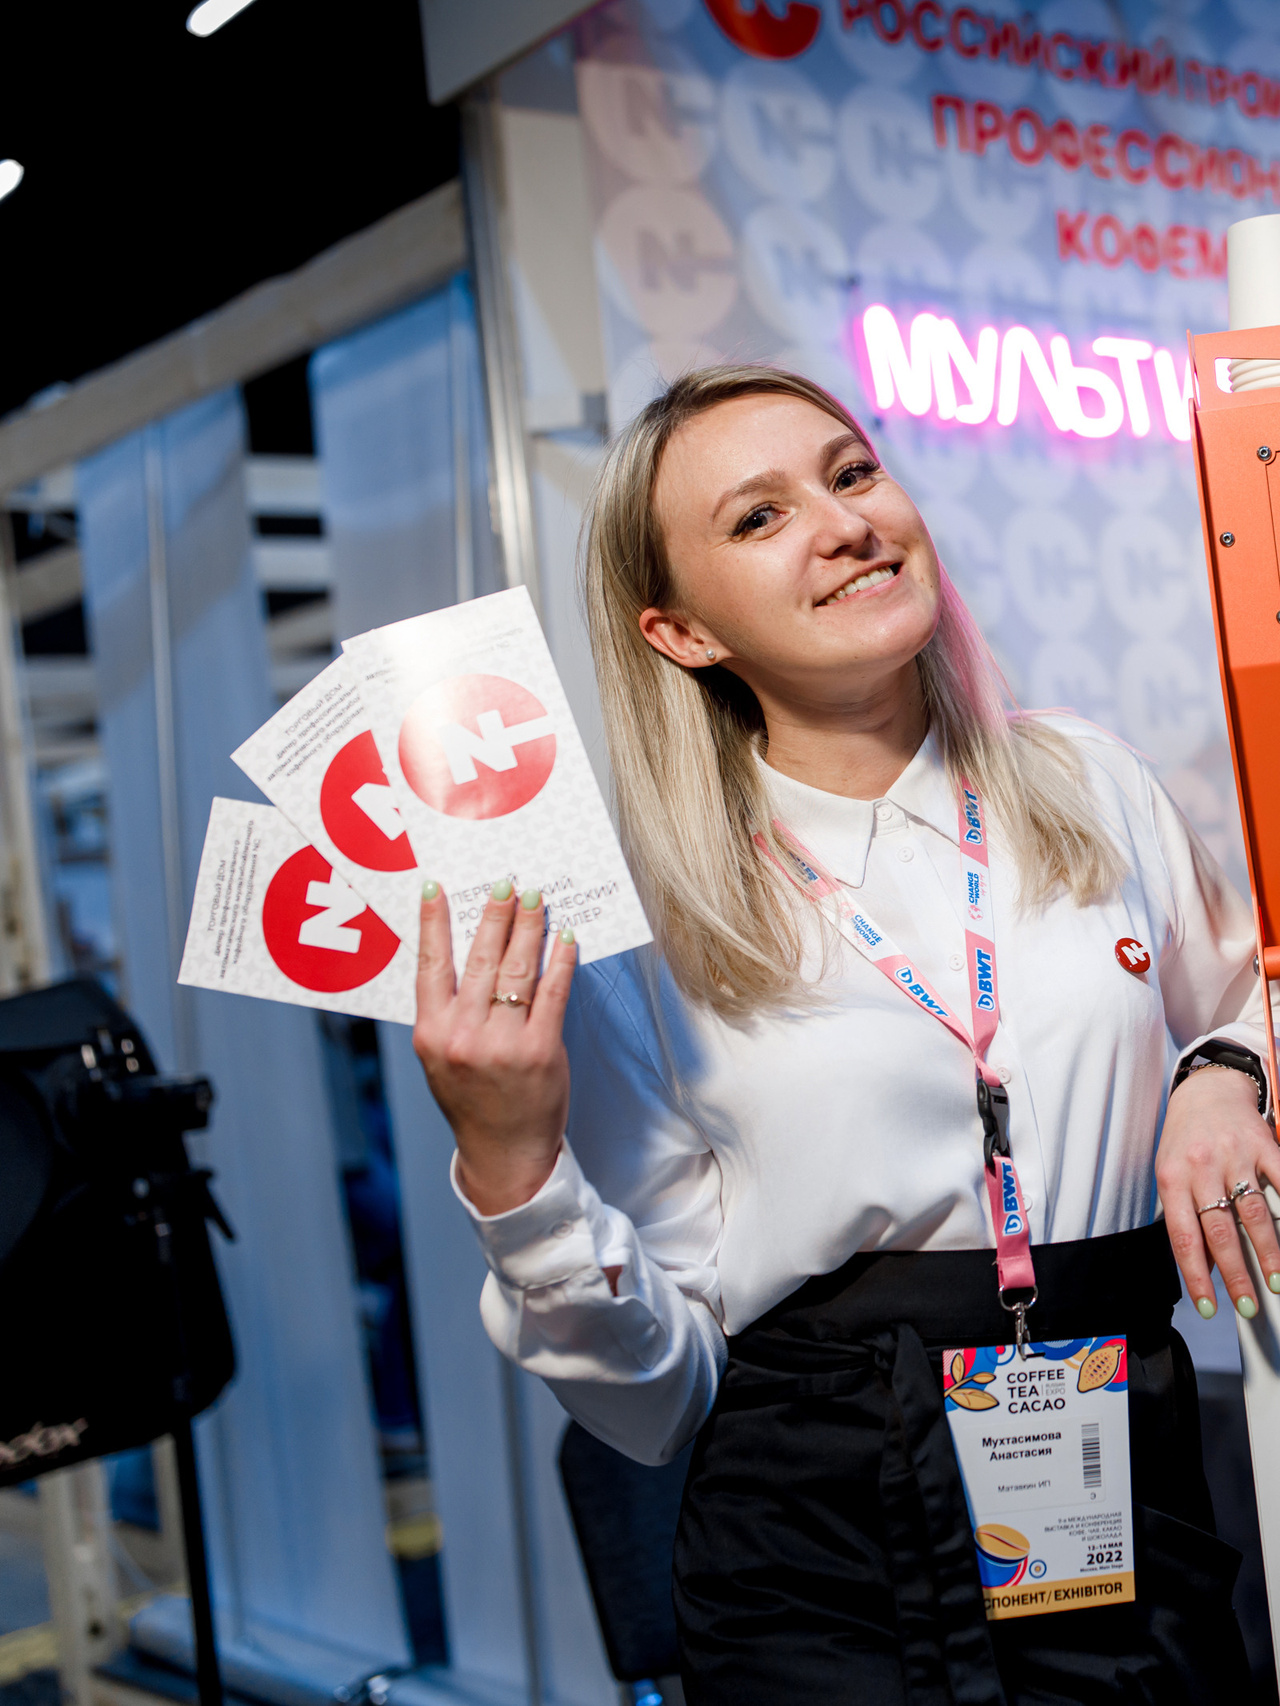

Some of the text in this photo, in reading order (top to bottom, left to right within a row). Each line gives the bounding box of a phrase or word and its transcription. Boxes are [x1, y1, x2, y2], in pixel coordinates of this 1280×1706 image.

[284, 683, 343, 736] ТОРГОВЫЙ ДОМ
[277, 739, 298, 760] дилер
[286, 742, 322, 777] кофейного
[207, 859, 226, 932] ТОРГОВЫЙ ДОМ
[214, 840, 240, 956] дилер профессионального
[450, 873, 518, 906] ПЕРВЙ
[967, 872, 975, 904] CHANGE
[233, 919, 246, 964] кофейного
[242, 854, 258, 916] оборудования
[854, 914, 883, 943] CHANGE
[854, 924, 876, 946] WORLD
[976, 948, 993, 993] BWT
[908, 983, 949, 1017] BWT
[1002, 1162, 1019, 1213] BWT
[1006, 1368, 1065, 1384] COFFEE
[1007, 1384, 1039, 1398] TEA
[1046, 1388, 1065, 1396] EXPO
[1008, 1398, 1066, 1414] CACAO
[982, 1431, 1062, 1449] Мухтасимова
[990, 1447, 1052, 1462] Анастасия
[1038, 1480, 1051, 1488] ИП
[1044, 1524, 1074, 1532] ВЫСТАВКА
[1081, 1518, 1122, 1528] КОНФЕРЕНЦИЯ
[1068, 1512, 1122, 1523] МЕЖДУНАРОДНАЯ
[1087, 1532, 1122, 1541] ШОКОЛАДА
[1108, 1541, 1122, 1549] МАЯ
[1087, 1550, 1122, 1565] 2022
